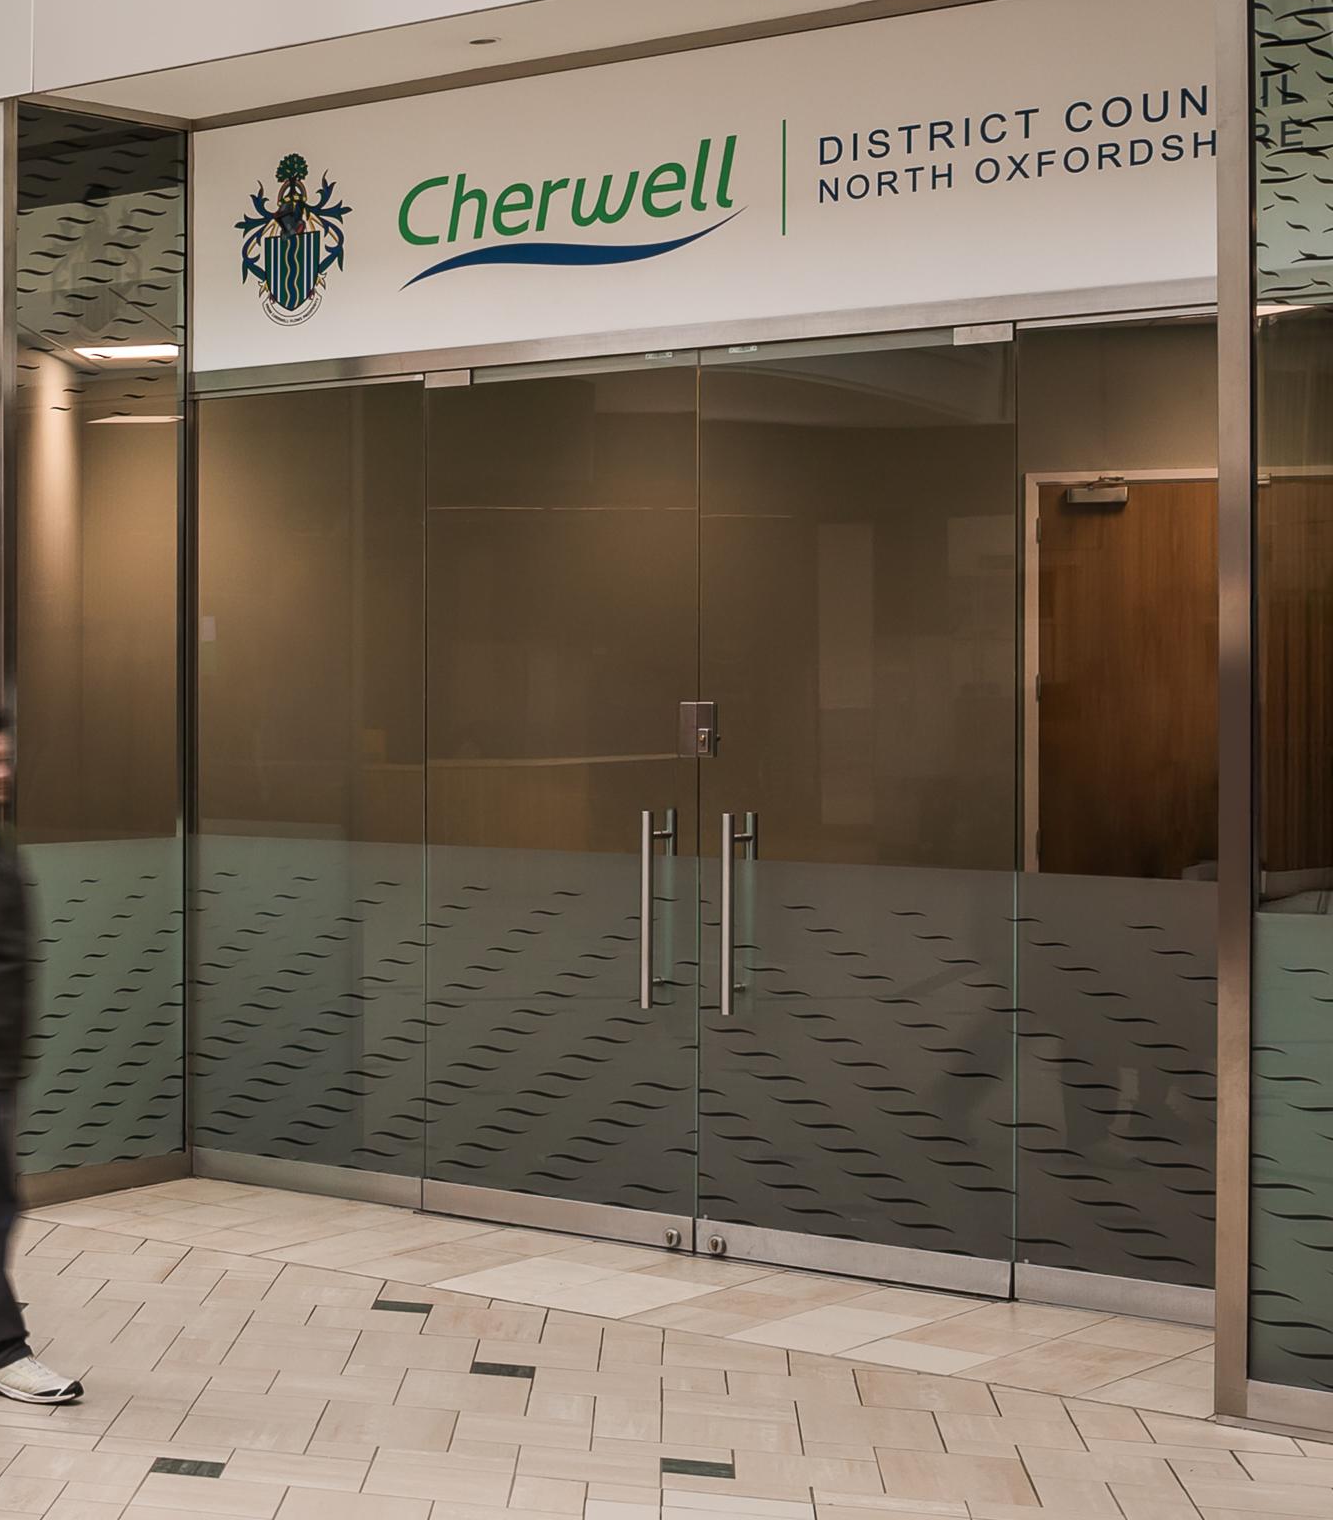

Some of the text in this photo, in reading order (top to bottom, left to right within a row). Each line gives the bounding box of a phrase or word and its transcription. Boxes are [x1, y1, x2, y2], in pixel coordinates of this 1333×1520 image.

[817, 107, 1041, 168] DISTRICT
[396, 133, 737, 248] Cherwell
[817, 161, 954, 205] NORTH
